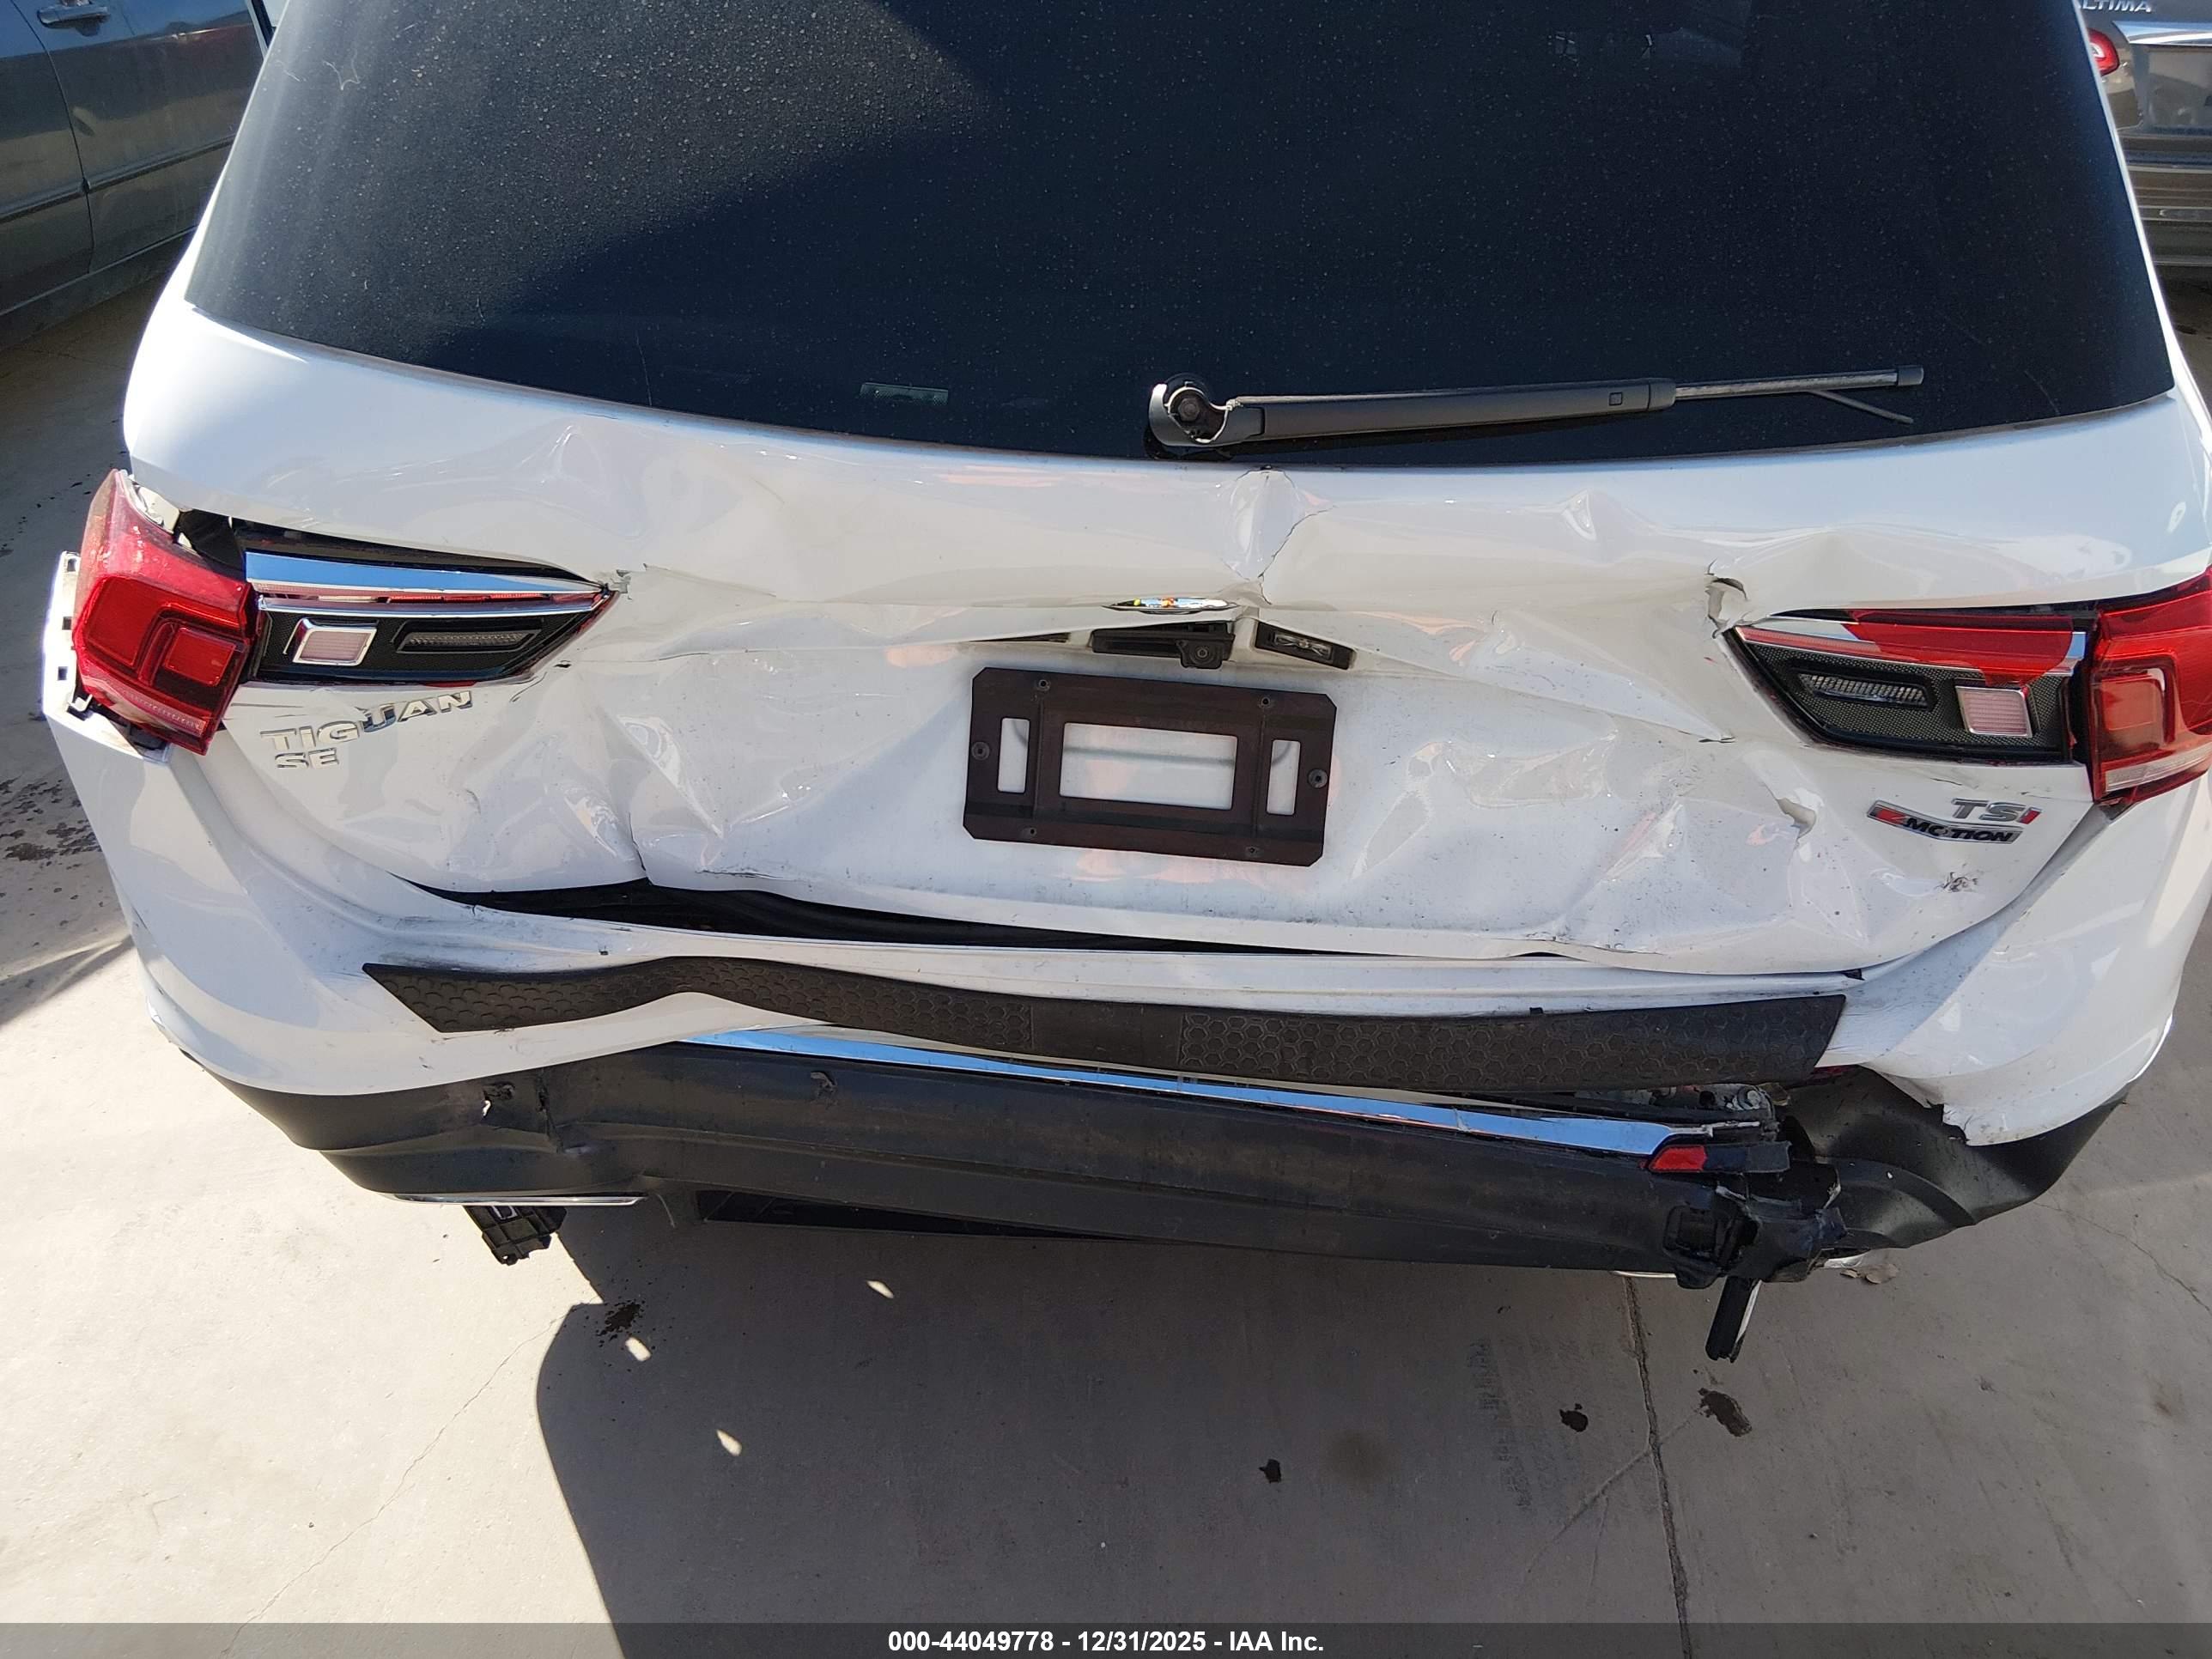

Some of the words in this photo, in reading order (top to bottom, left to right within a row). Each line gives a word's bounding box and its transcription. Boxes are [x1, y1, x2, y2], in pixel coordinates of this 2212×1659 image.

[2078, 0, 2151, 12] LTIMA
[259, 690, 473, 750] TIGUAN
[274, 747, 340, 769] SE
